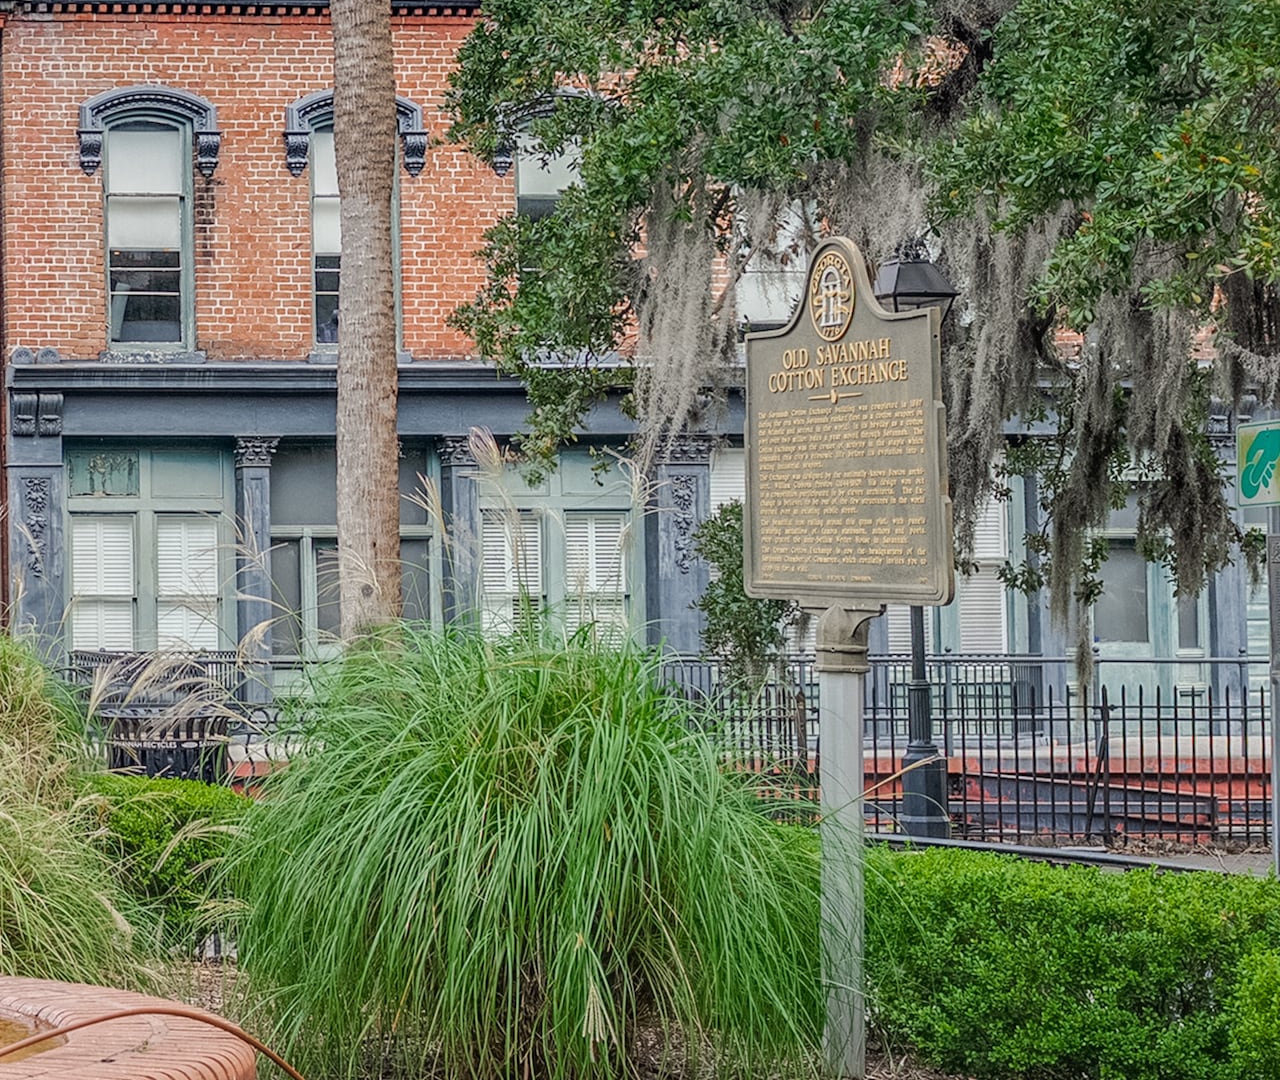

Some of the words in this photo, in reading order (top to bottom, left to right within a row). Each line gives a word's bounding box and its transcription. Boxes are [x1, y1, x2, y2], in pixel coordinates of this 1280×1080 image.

[811, 254, 852, 294] GEORGIA
[783, 348, 809, 370] OLD
[816, 338, 891, 366] SAVANNAH
[769, 369, 825, 393] COTTON
[831, 360, 909, 387] EXCHANGE
[143, 741, 177, 749] RECYCLES
